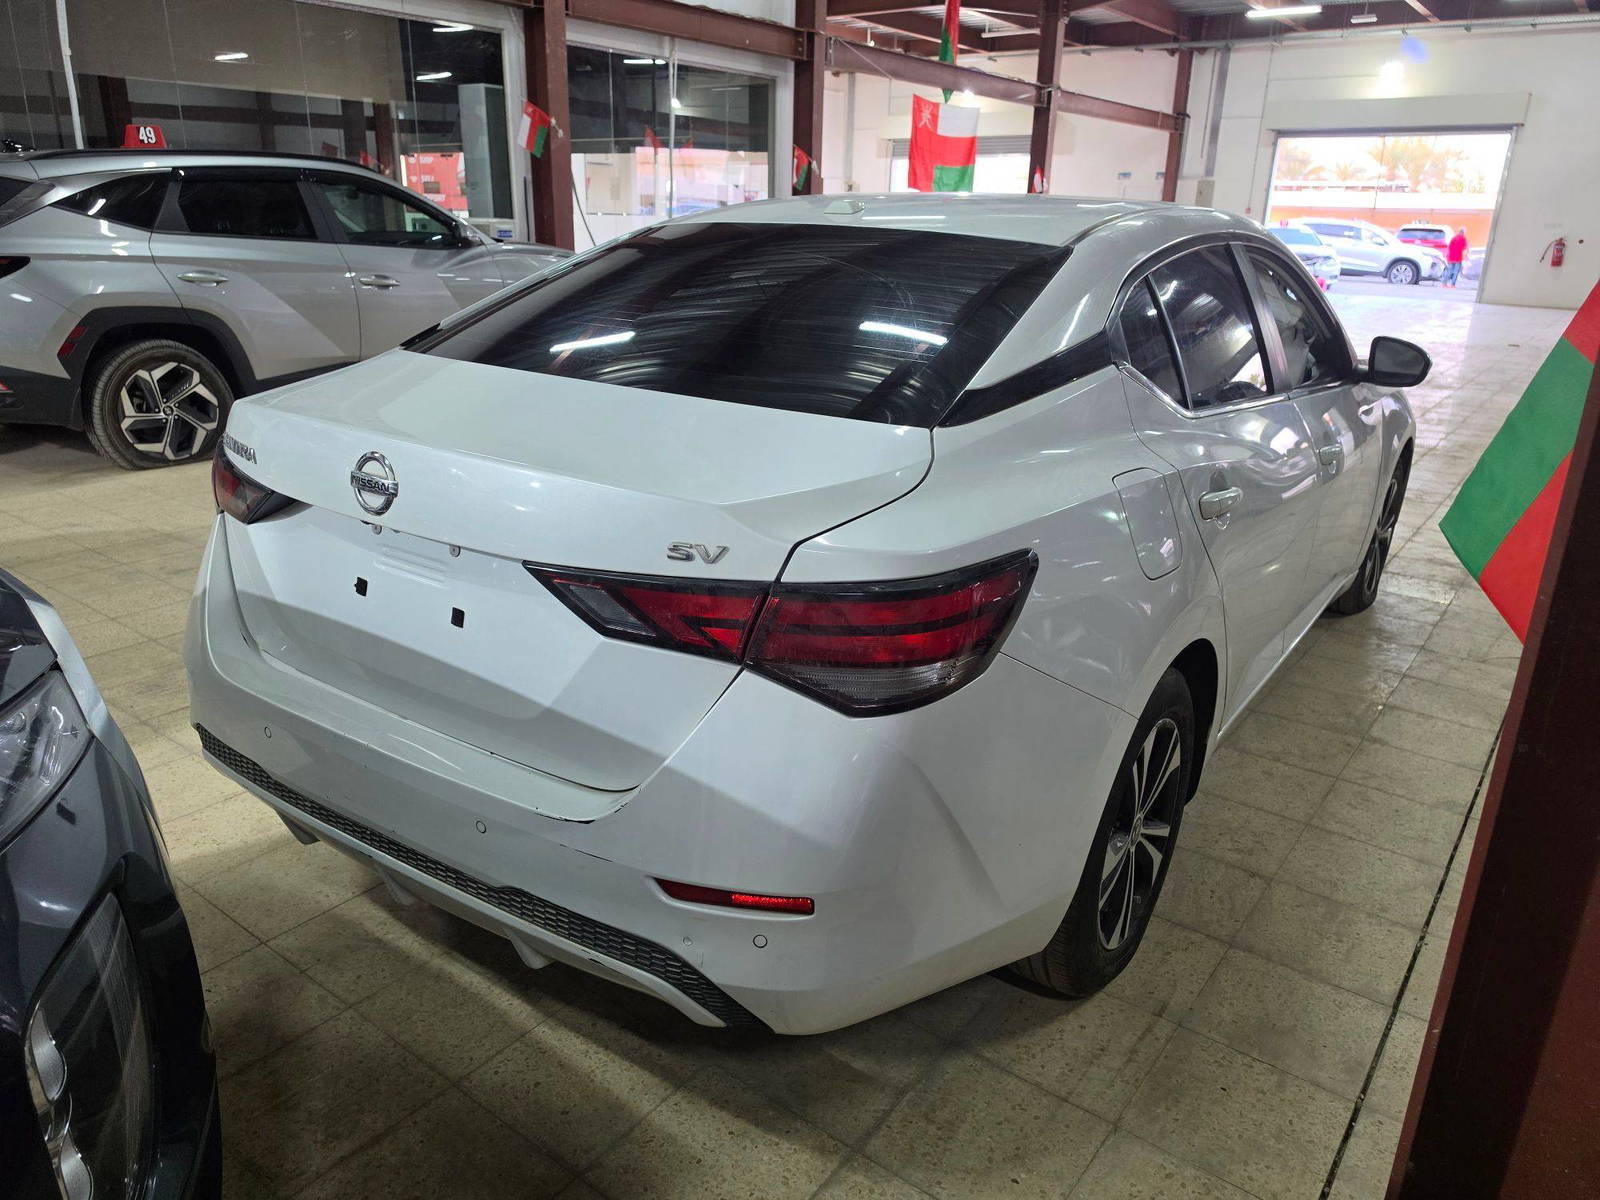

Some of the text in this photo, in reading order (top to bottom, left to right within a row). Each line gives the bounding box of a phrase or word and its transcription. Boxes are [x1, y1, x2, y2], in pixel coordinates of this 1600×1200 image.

[139, 126, 156, 144] 49
[352, 474, 390, 493] NISSAN
[667, 542, 729, 565] SV
